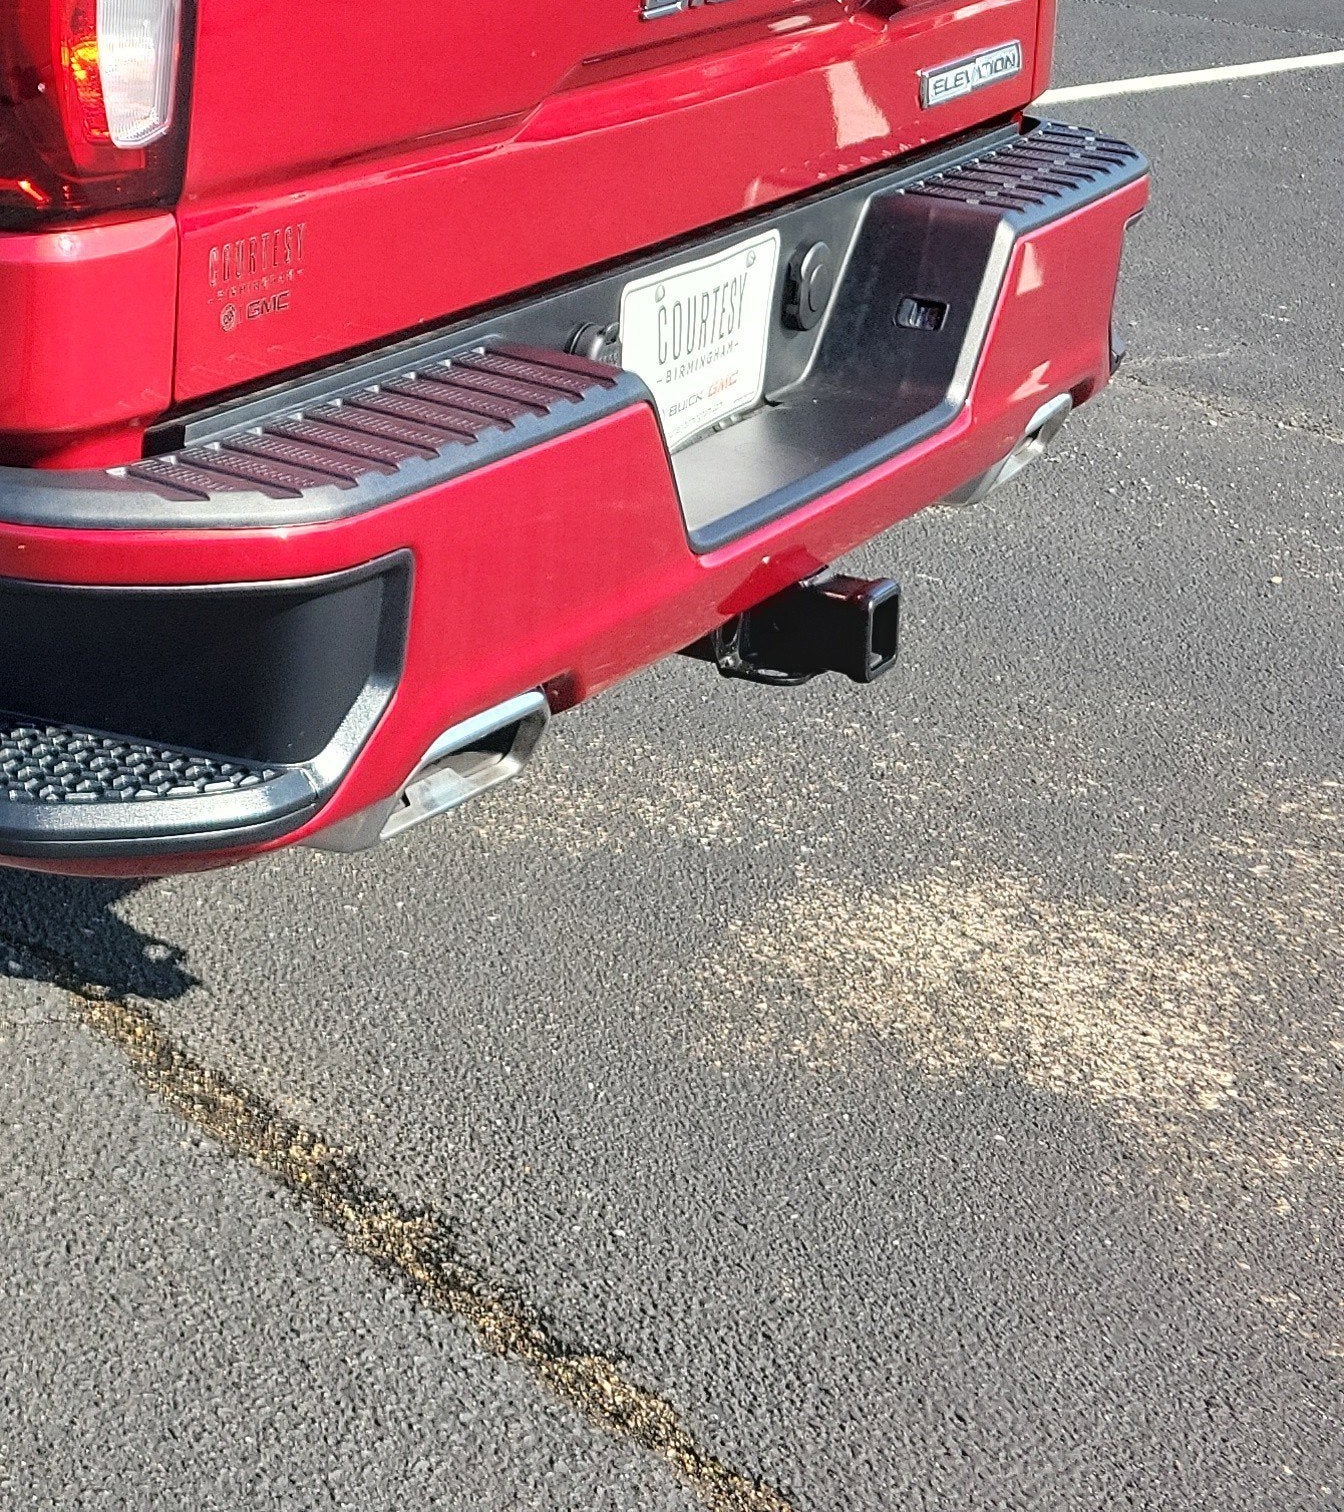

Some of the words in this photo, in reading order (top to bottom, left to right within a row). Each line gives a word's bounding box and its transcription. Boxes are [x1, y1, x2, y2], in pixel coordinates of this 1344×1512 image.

[209, 223, 307, 287] COURTESY
[246, 290, 290, 320] GMC
[657, 272, 748, 365] COURTESY
[668, 390, 705, 418] BUICK
[707, 369, 739, 398] GMC
